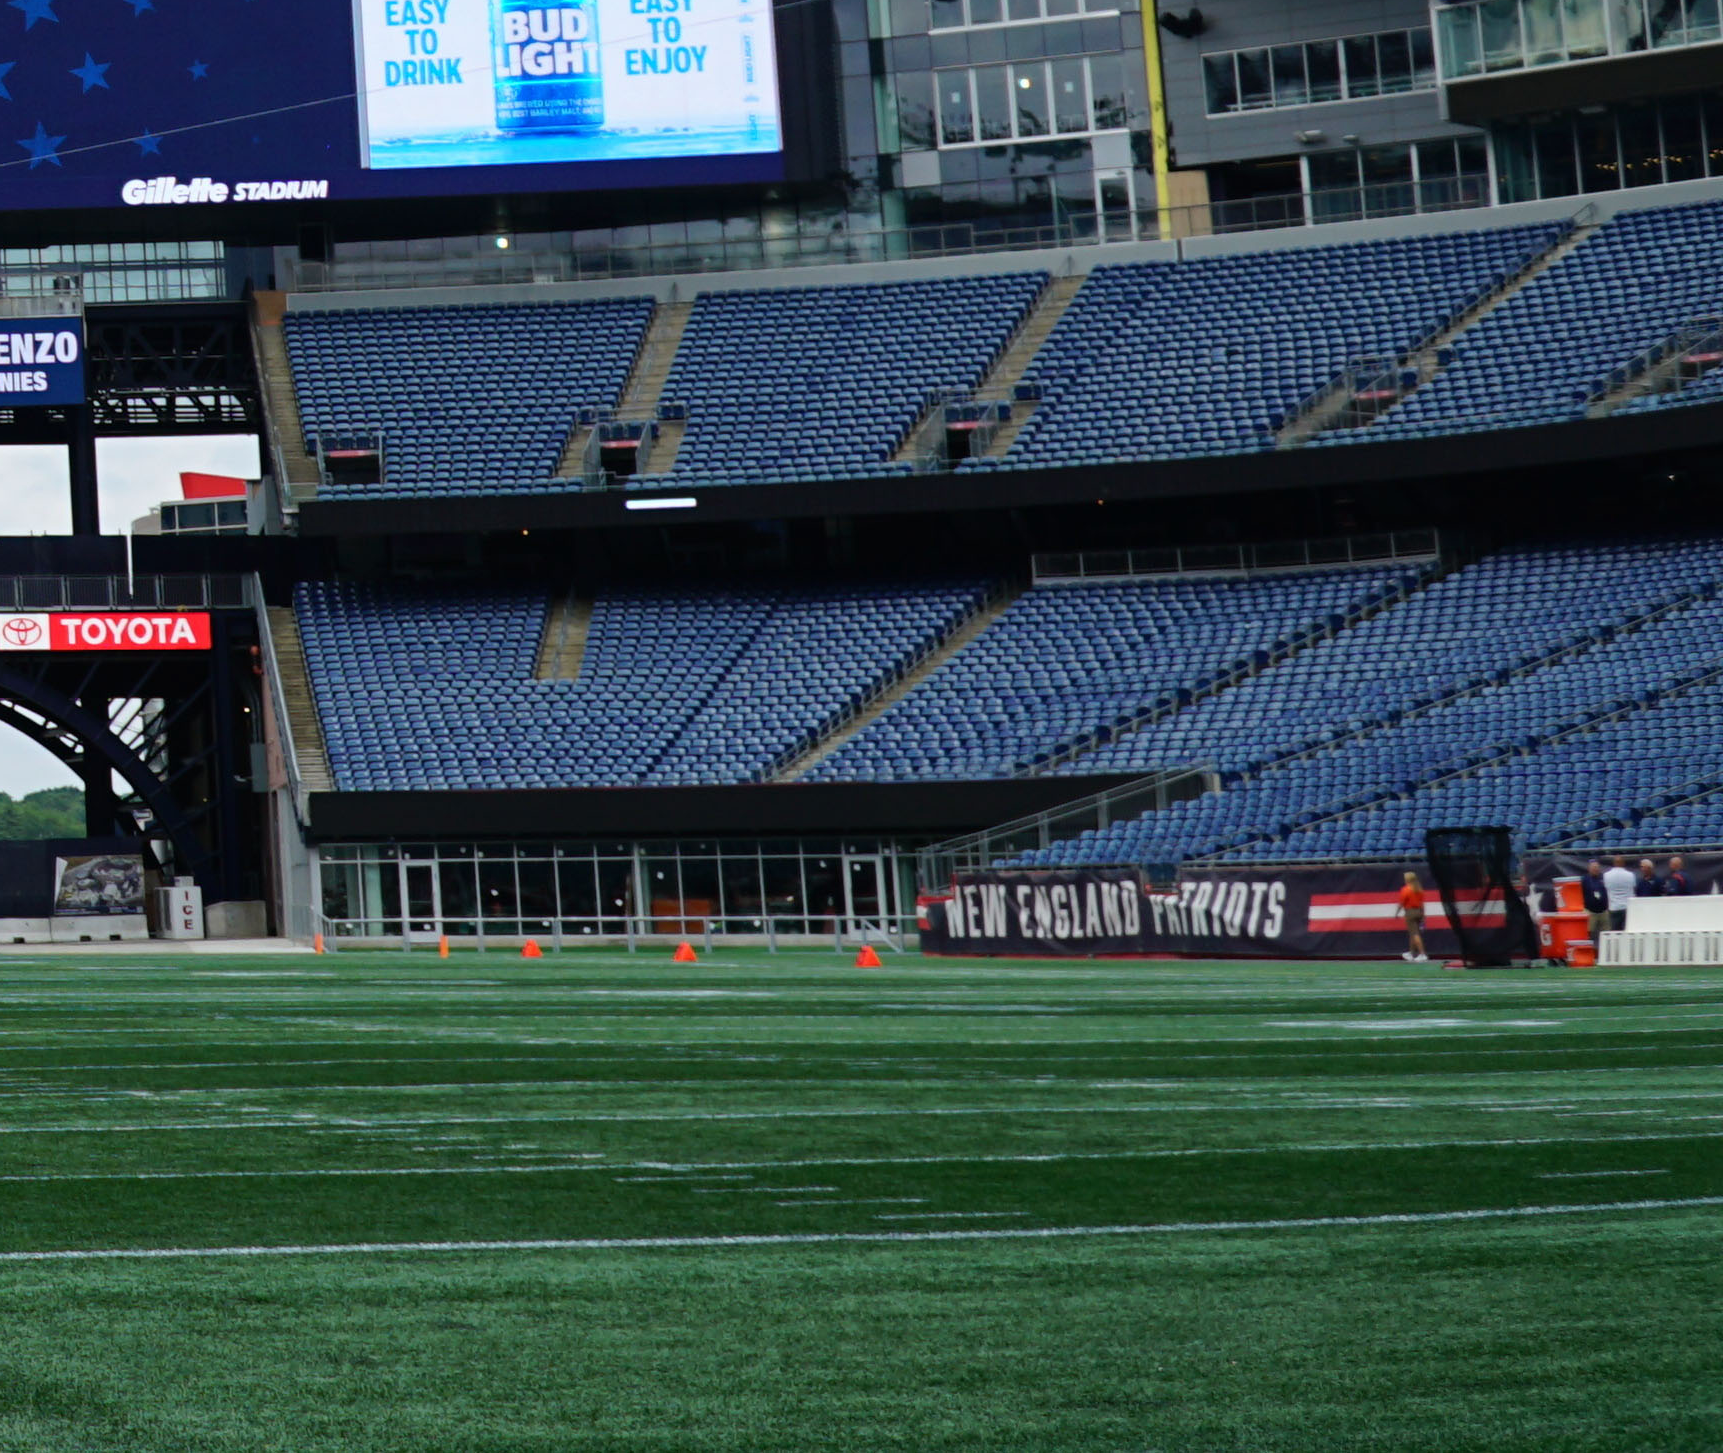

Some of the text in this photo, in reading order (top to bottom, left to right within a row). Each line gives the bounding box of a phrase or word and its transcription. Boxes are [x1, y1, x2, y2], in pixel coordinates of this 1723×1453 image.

[504, 8, 587, 44] BUD
[647, 16, 681, 43] TO
[405, 29, 437, 55] TO
[385, 58, 462, 86] DRINK
[496, 42, 599, 77] LIGHT
[626, 46, 706, 75] ENJOY
[122, 177, 328, 205] Gillette STADIUM
[61, 617, 196, 644] TOYOTA
[182, 890, 194, 931] ICE
[944, 884, 1006, 938] NEW
[1017, 881, 1140, 939] ENGLAND
